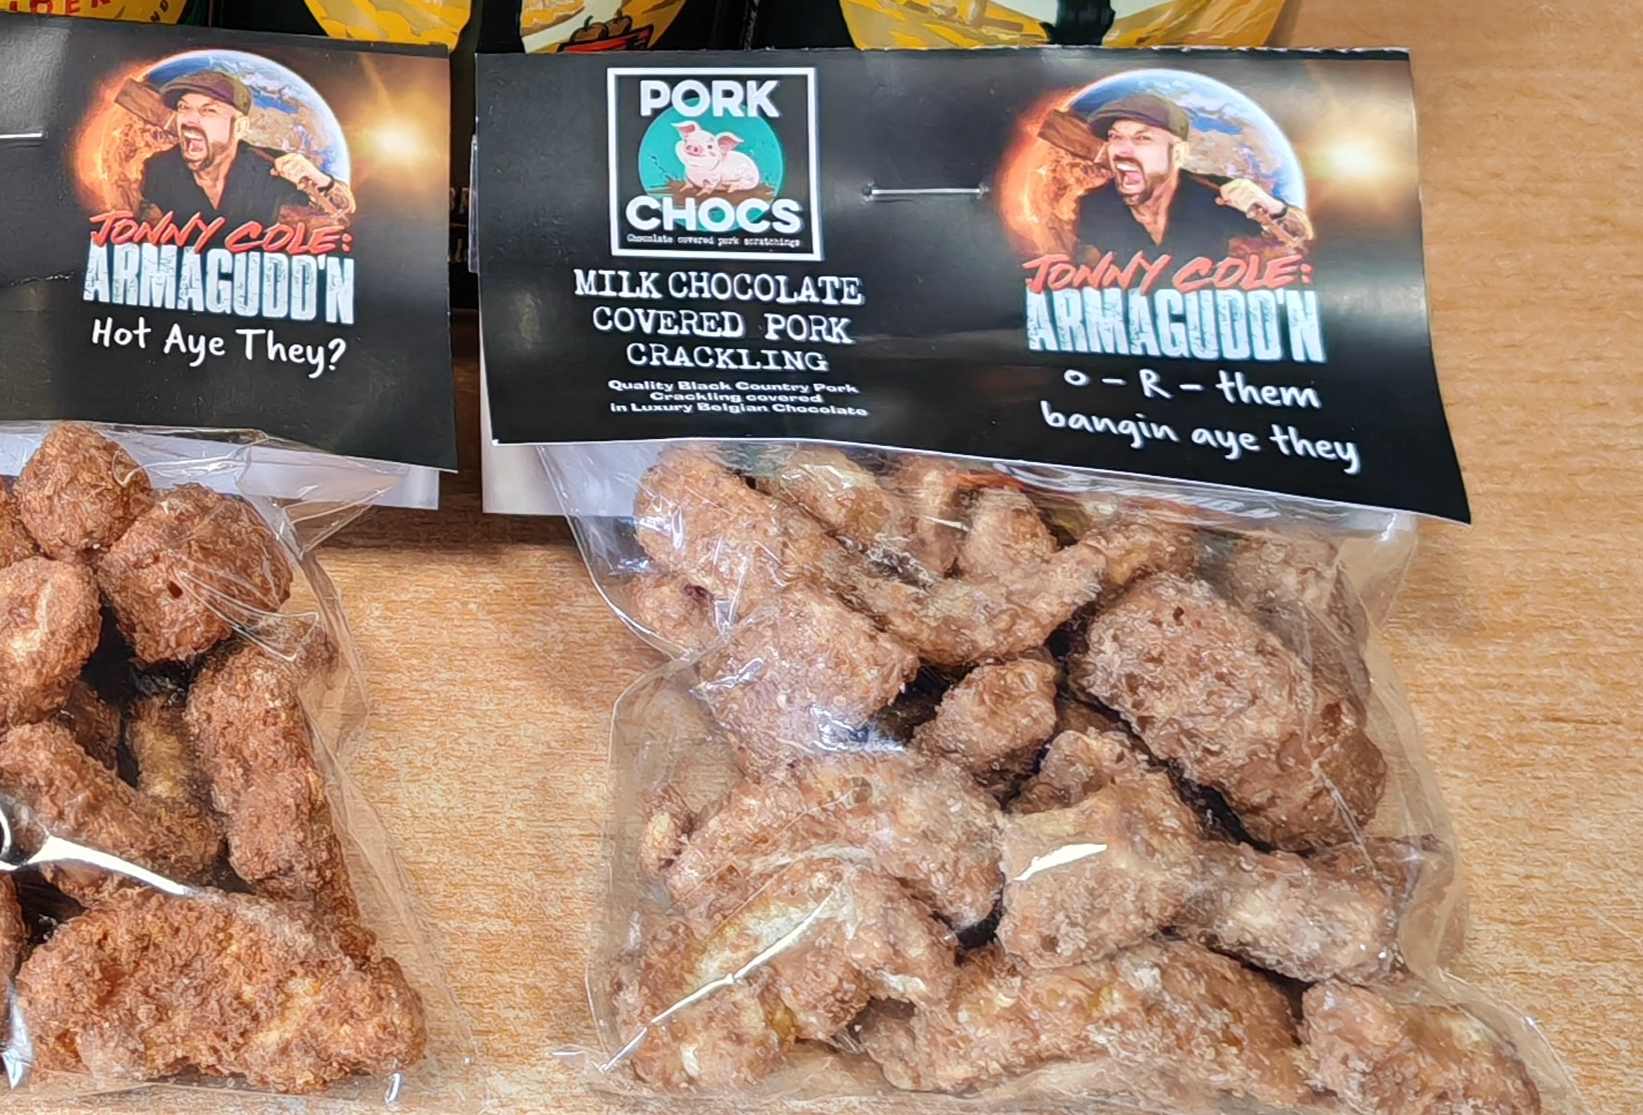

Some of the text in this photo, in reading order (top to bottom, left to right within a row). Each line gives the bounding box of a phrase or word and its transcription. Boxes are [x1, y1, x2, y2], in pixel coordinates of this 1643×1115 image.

[639, 78, 783, 118] PORK
[89, 210, 354, 255] JONNY COLE:
[625, 195, 804, 234] CHOCS
[82, 240, 355, 325] ARMAGUDD'N
[573, 268, 866, 306] MILK CHOCOLATE
[1022, 251, 1314, 293] JONNY COLE:
[591, 306, 857, 345] COVERED PORK
[1024, 286, 1326, 364] ARMAGUDD'N
[91, 317, 347, 379] Hot Aye They?
[625, 343, 829, 373] CRACKLING
[608, 379, 860, 394] Quality Black Country Pork
[649, 391, 824, 403] Crackling covered
[1215, 371, 1322, 410] them
[610, 403, 870, 416] in Luxury Belgian Chocolate
[1040, 401, 1362, 477] bangin aye they
